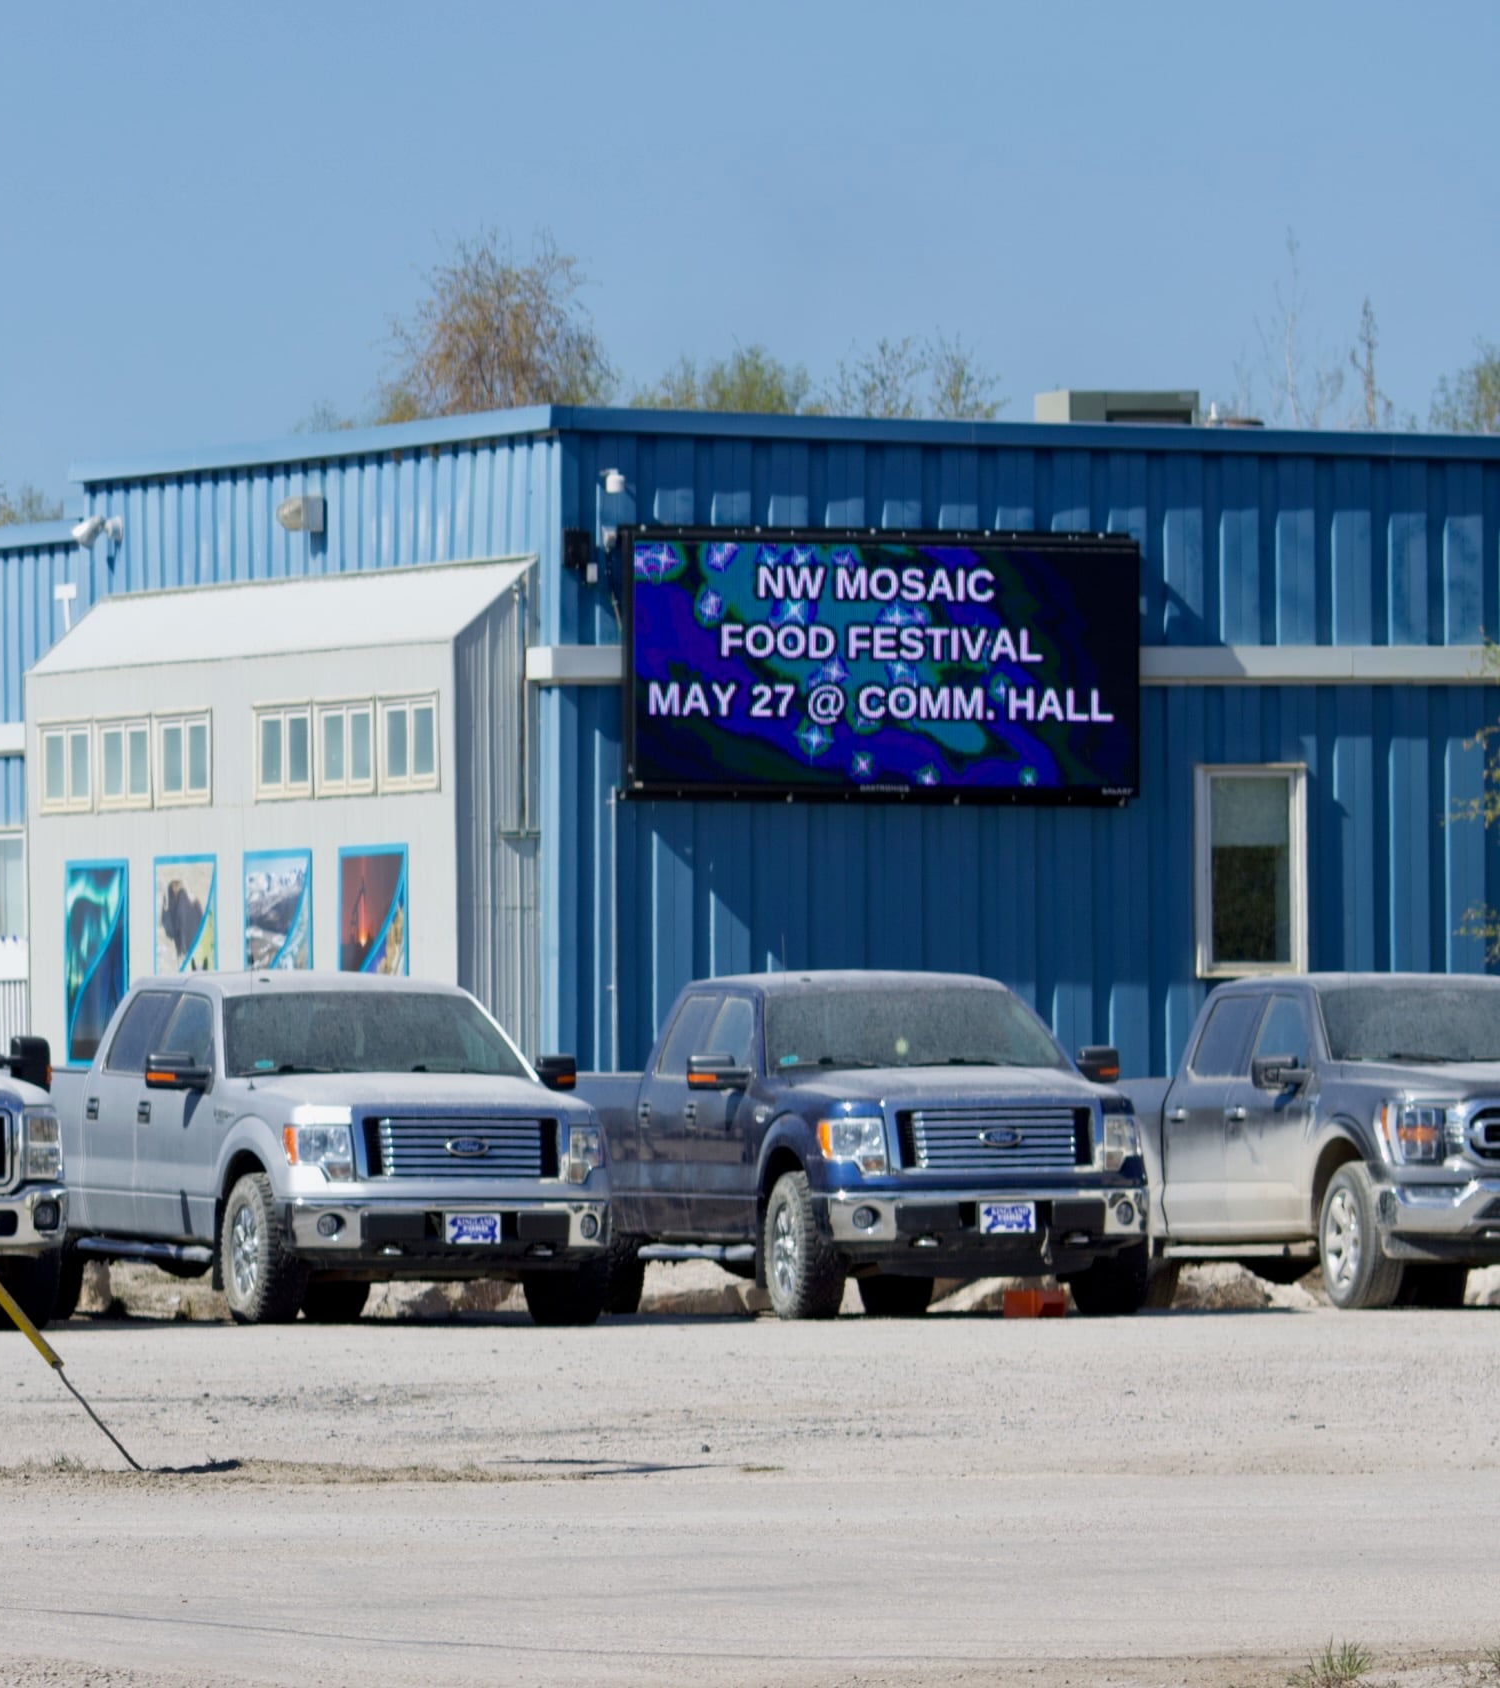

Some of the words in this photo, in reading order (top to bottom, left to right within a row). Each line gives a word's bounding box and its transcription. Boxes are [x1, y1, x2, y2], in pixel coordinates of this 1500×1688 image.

[757, 565, 825, 600] NW
[835, 567, 996, 602] MOSAIC
[720, 623, 836, 659] FOOD
[847, 625, 1044, 663] FESTIVAL
[648, 681, 736, 717] MAY
[750, 684, 796, 718] 27
[807, 683, 845, 725] @
[857, 685, 996, 720] COMM.
[1007, 687, 1115, 723] HALL
